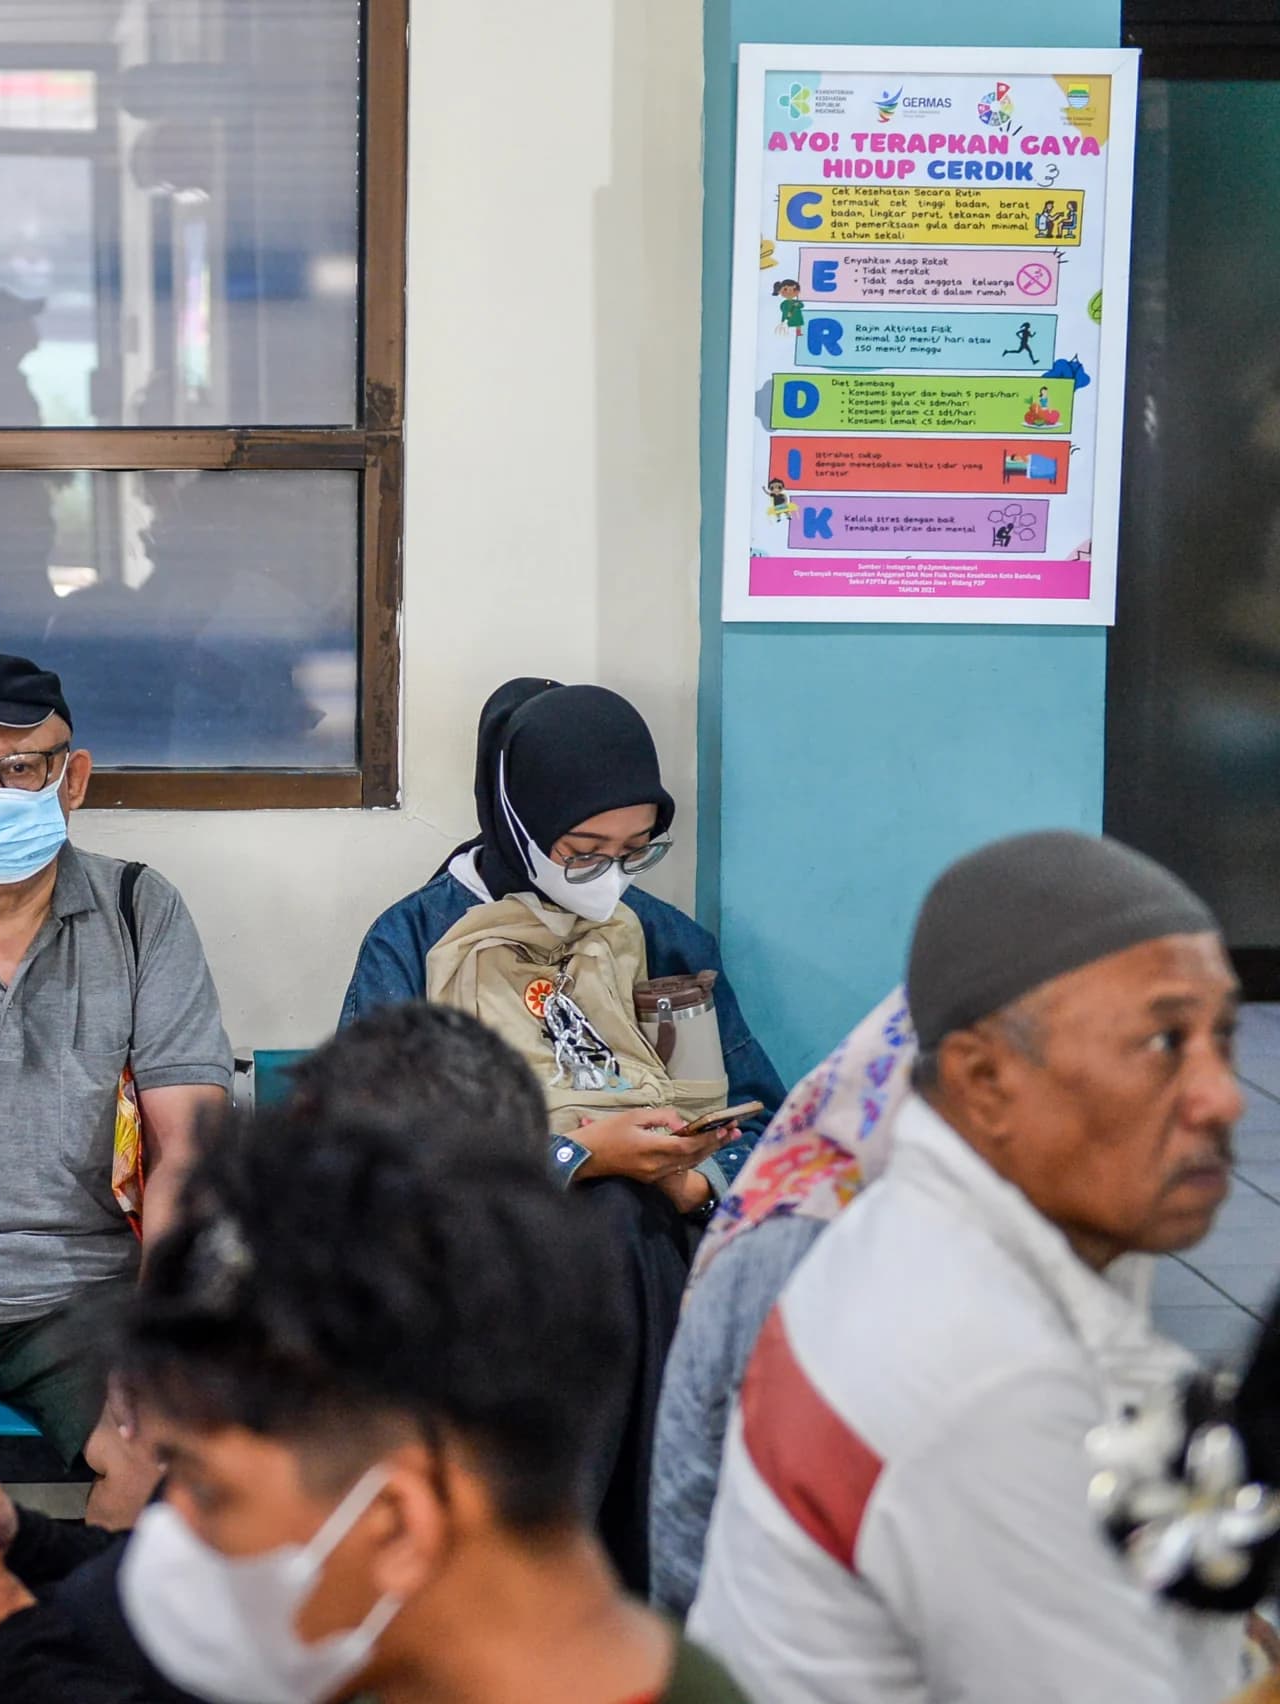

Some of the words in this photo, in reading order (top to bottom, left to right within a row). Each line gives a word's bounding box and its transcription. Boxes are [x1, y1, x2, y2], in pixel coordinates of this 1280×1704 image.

[902, 97, 952, 108] GERMAS
[768, 132, 840, 152] AYO!
[851, 132, 1008, 155] TERAPKAN
[1020, 134, 1101, 156] GAYA
[822, 158, 916, 180] HIDUP
[926, 160, 1032, 182] CERDIK
[831, 188, 850, 196] Cek
[854, 188, 910, 196] Kesehatan
[914, 188, 950, 196] Secara
[955, 189, 981, 197] Rutin
[918, 200, 946, 209] tinggi
[955, 200, 990, 208] badan,
[1000, 200, 1030, 209] berat
[786, 191, 824, 230] C
[830, 210, 865, 218] badan,
[870, 210, 906, 219] lingkar
[912, 210, 942, 220] perut,
[948, 212, 990, 220] tekanan
[996, 212, 1030, 220] darah,
[830, 220, 849, 228] dan
[856, 220, 920, 231] pemeriksaan
[926, 222, 948, 232] gula
[954, 222, 986, 230] darah
[992, 222, 1028, 231] minimal
[842, 232, 871, 240] tahun
[874, 232, 904, 240] sekali
[844, 256, 890, 266] Enyahkan
[895, 258, 918, 266] Asap
[922, 258, 948, 266] Rokok
[812, 260, 840, 292] E
[862, 267, 886, 275] Tidak
[890, 268, 930, 276] merokok
[896, 278, 914, 286] ada
[924, 278, 962, 287] anggota
[972, 278, 1014, 288] keluarga
[862, 288, 884, 296] yang
[888, 288, 928, 296] merokok
[932, 288, 940, 296] di
[944, 288, 972, 296] dalam
[856, 324, 880, 332] Rajin
[807, 318, 844, 356] R
[854, 334, 890, 342] minimal
[910, 335, 940, 344] menit/
[944, 336, 965, 344] hari
[910, 346, 942, 355] minggu
[854, 380, 895, 388] Seimbang
[783, 380, 820, 419] D
[890, 390, 916, 398] sayur
[920, 390, 938, 398] dan
[974, 391, 1020, 399] porsi/hari
[848, 398, 888, 406] Konsumsi
[890, 399, 910, 408] gula
[930, 400, 970, 408] sdm/hari
[848, 408, 888, 416] Konsumsi
[890, 418, 916, 426] lemak
[921, 418, 932, 426] <5
[936, 418, 976, 426] sdm/hari
[787, 448, 802, 481] I
[803, 507, 833, 540] K
